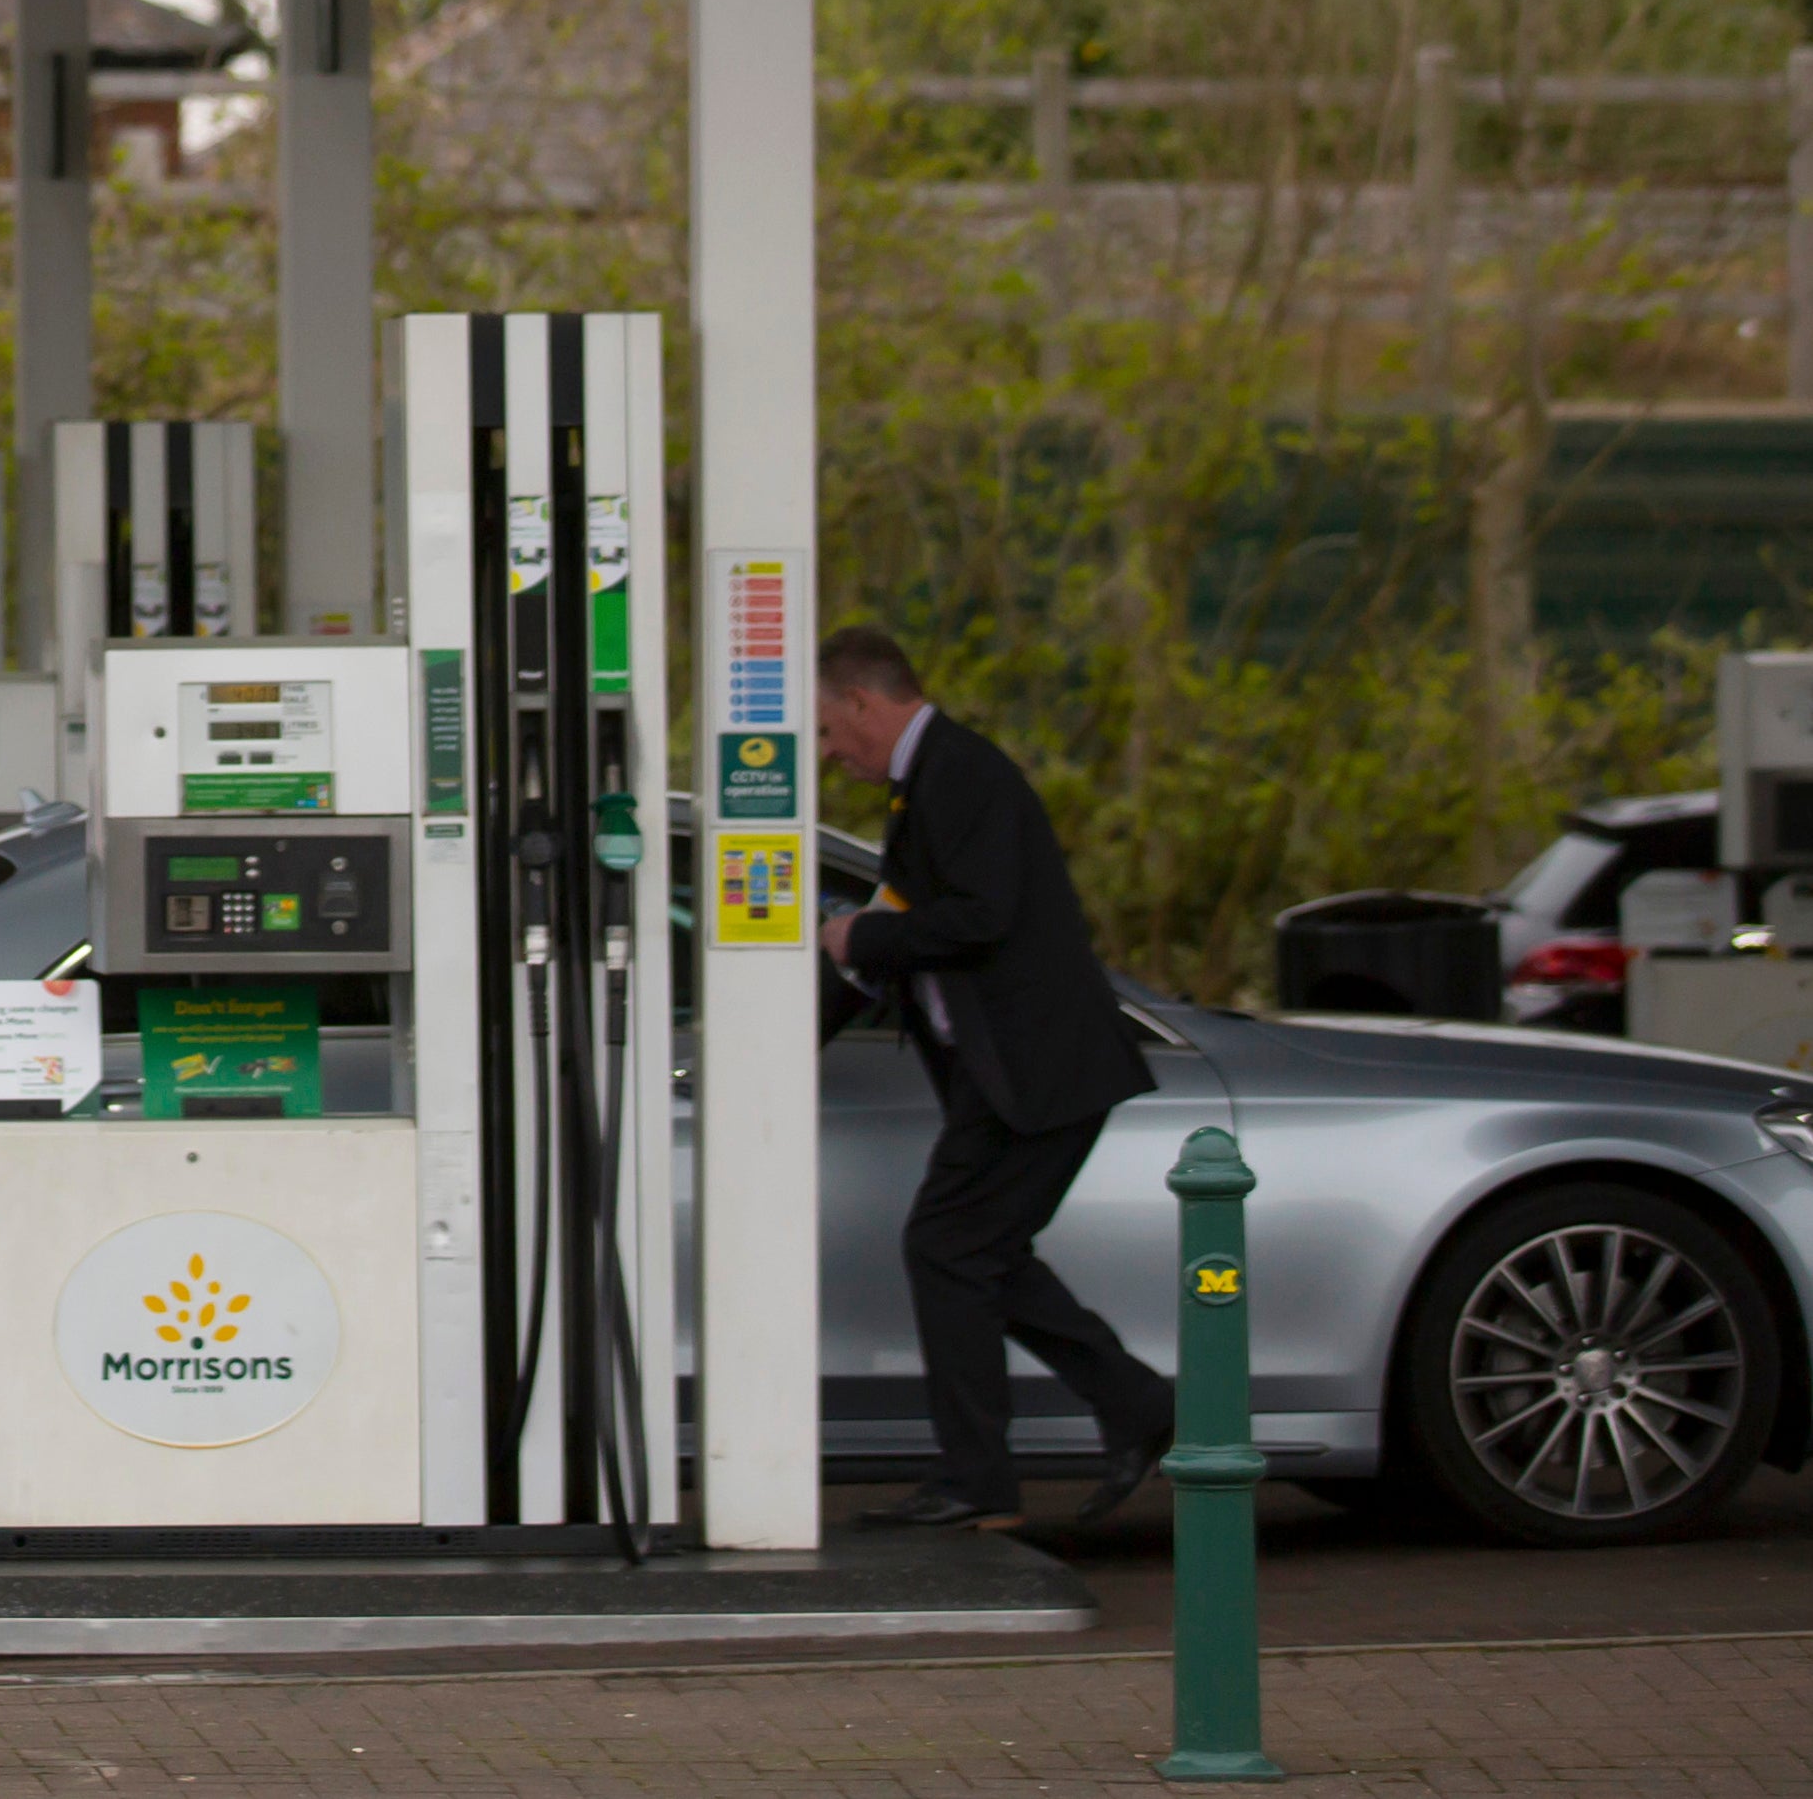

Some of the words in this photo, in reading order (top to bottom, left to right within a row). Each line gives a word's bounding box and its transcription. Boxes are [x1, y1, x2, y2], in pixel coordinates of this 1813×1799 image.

[729, 770, 768, 784] CCTV
[769, 770, 785, 784] in
[723, 785, 792, 798] operation
[174, 1000, 226, 1015] Don't
[228, 998, 285, 1018] forget
[1197, 1268, 1238, 1294] M
[101, 1337, 293, 1380] Morrisons
[172, 1385, 198, 1393] Since
